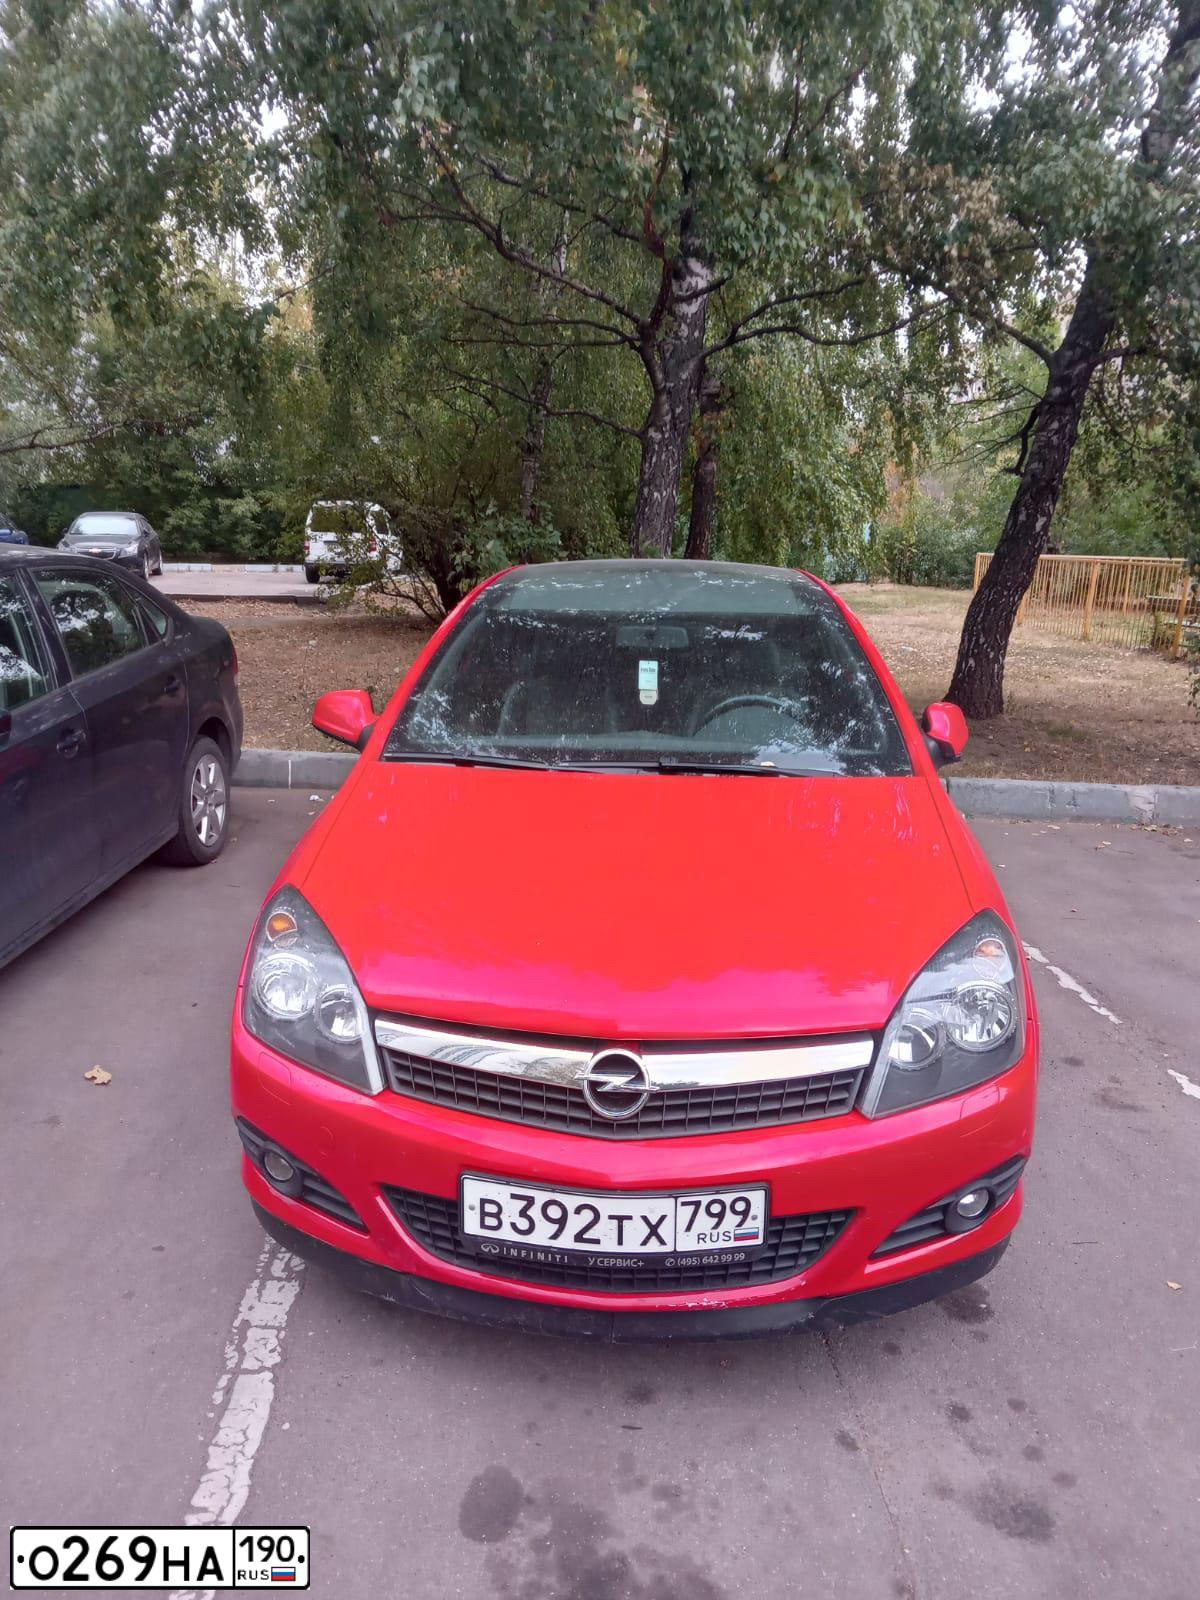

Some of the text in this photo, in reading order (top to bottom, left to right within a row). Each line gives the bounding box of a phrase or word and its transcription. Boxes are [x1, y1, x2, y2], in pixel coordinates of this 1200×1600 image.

[680, 1196, 752, 1232] 799
[697, 1231, 732, 1244] RUS
[503, 1247, 568, 1263] INFINITI
[677, 1252, 745, 1266] (495) 642 99 99
